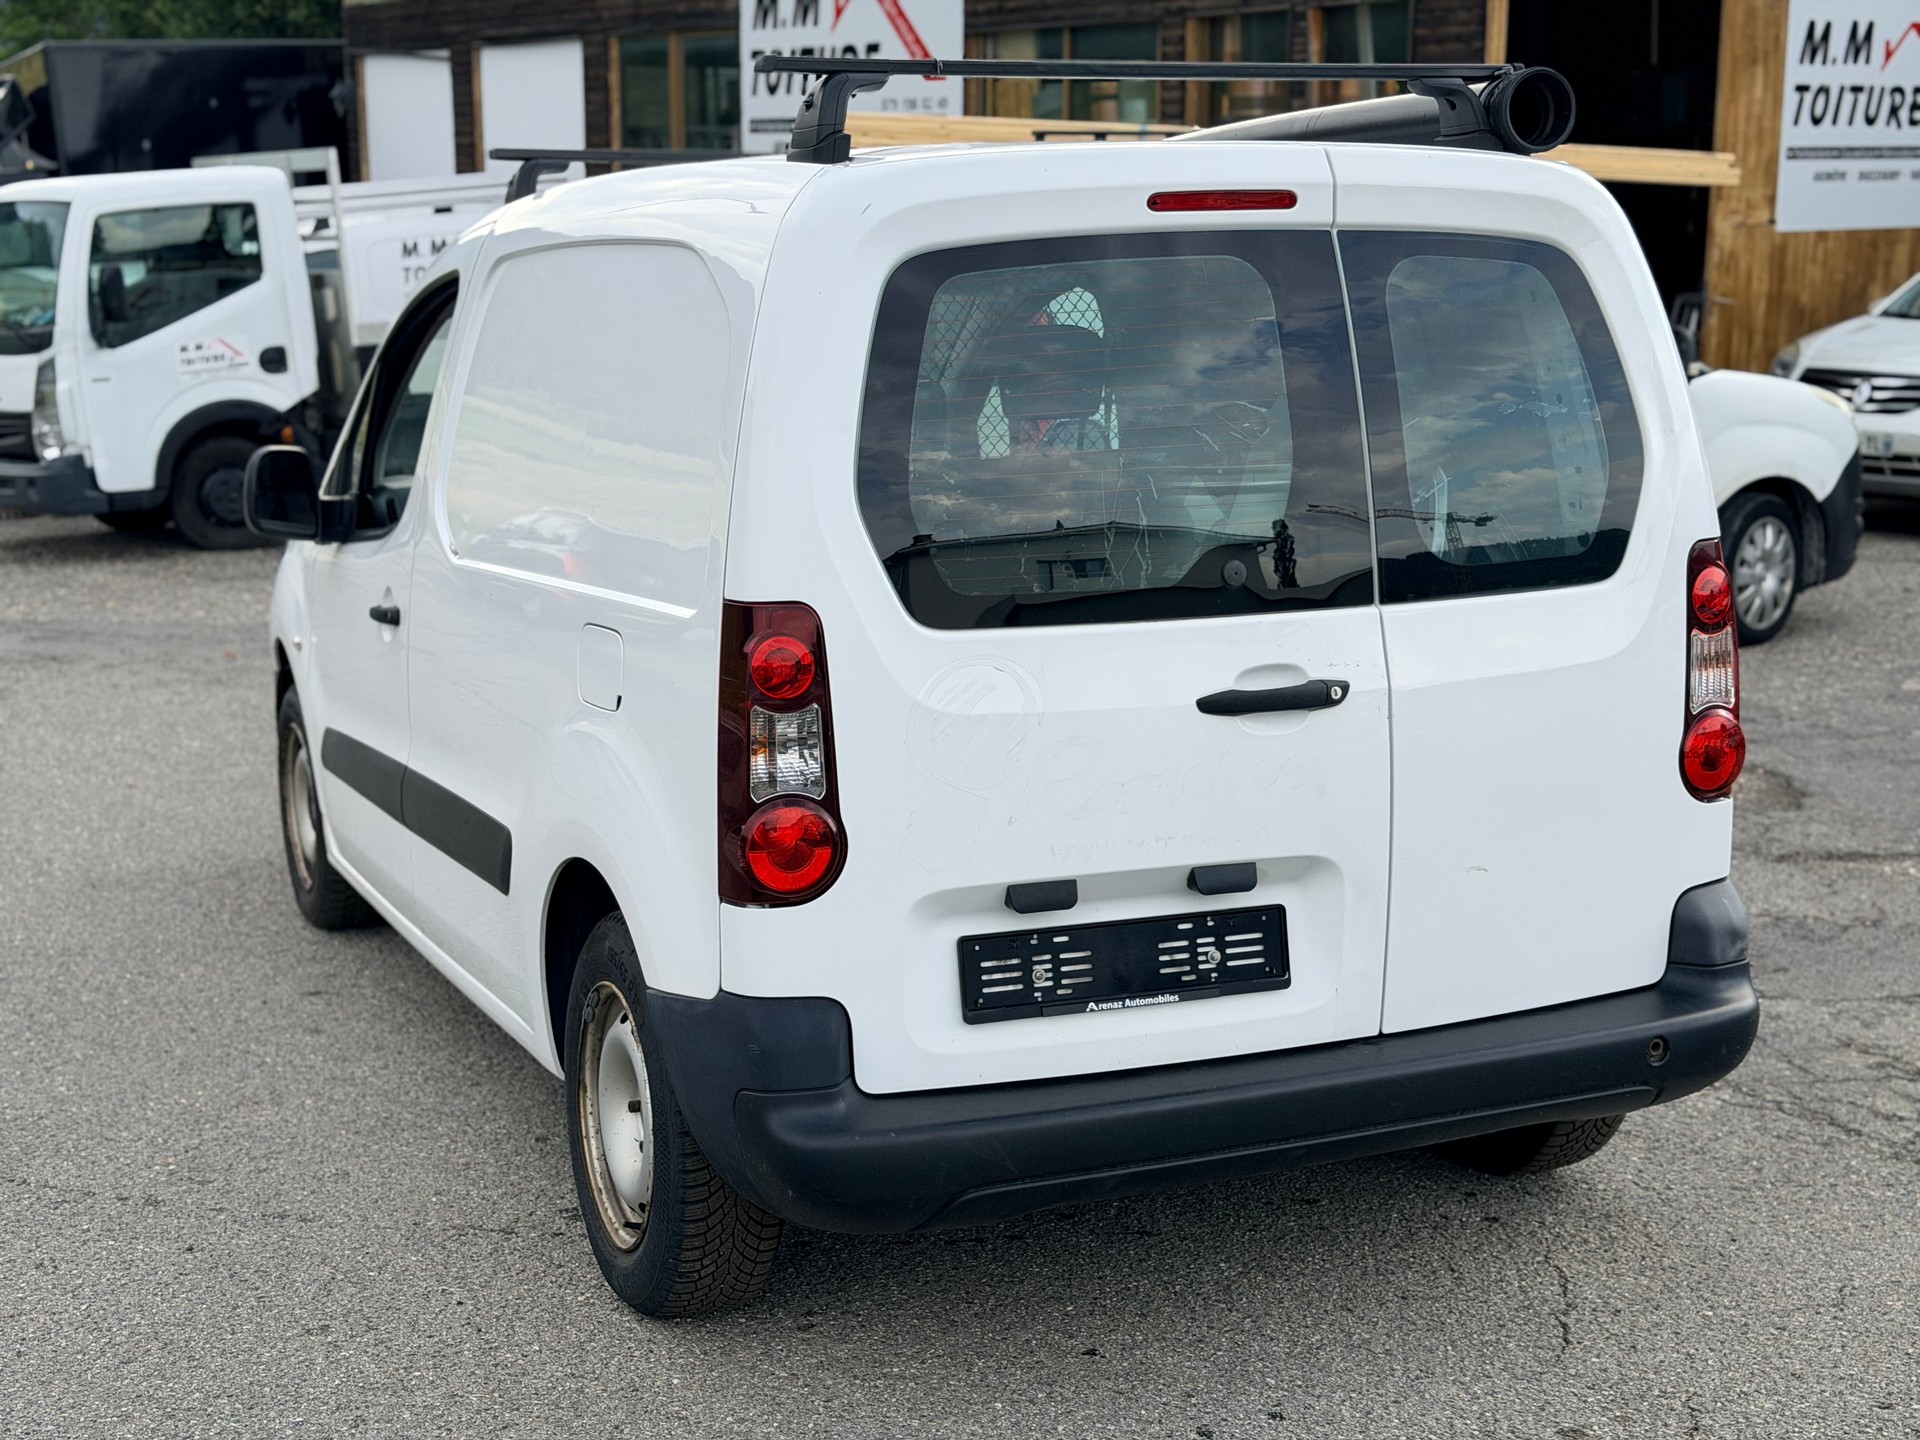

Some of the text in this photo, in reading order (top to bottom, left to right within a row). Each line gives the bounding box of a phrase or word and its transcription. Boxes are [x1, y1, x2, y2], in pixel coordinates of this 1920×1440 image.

[1800, 20, 1874, 65] M.M
[1086, 993, 1179, 1012] Arenaz Automobiles
